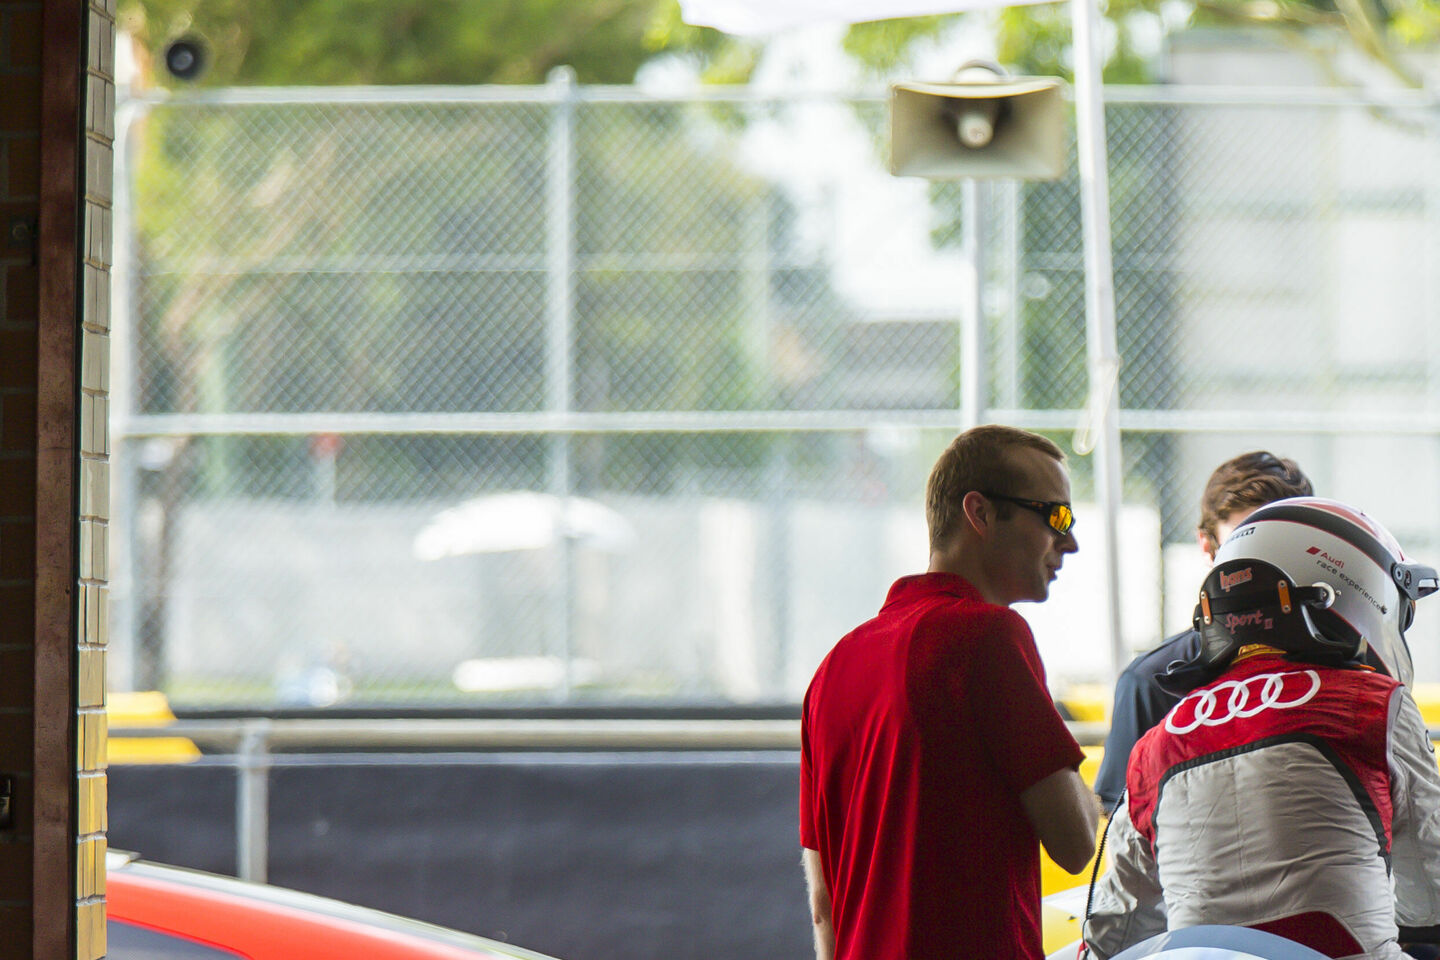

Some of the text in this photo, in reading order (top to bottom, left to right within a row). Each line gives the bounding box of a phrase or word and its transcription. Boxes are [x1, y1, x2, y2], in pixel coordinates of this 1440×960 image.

[1320, 552, 1345, 569] Audi
[1316, 560, 1381, 610] race experience
